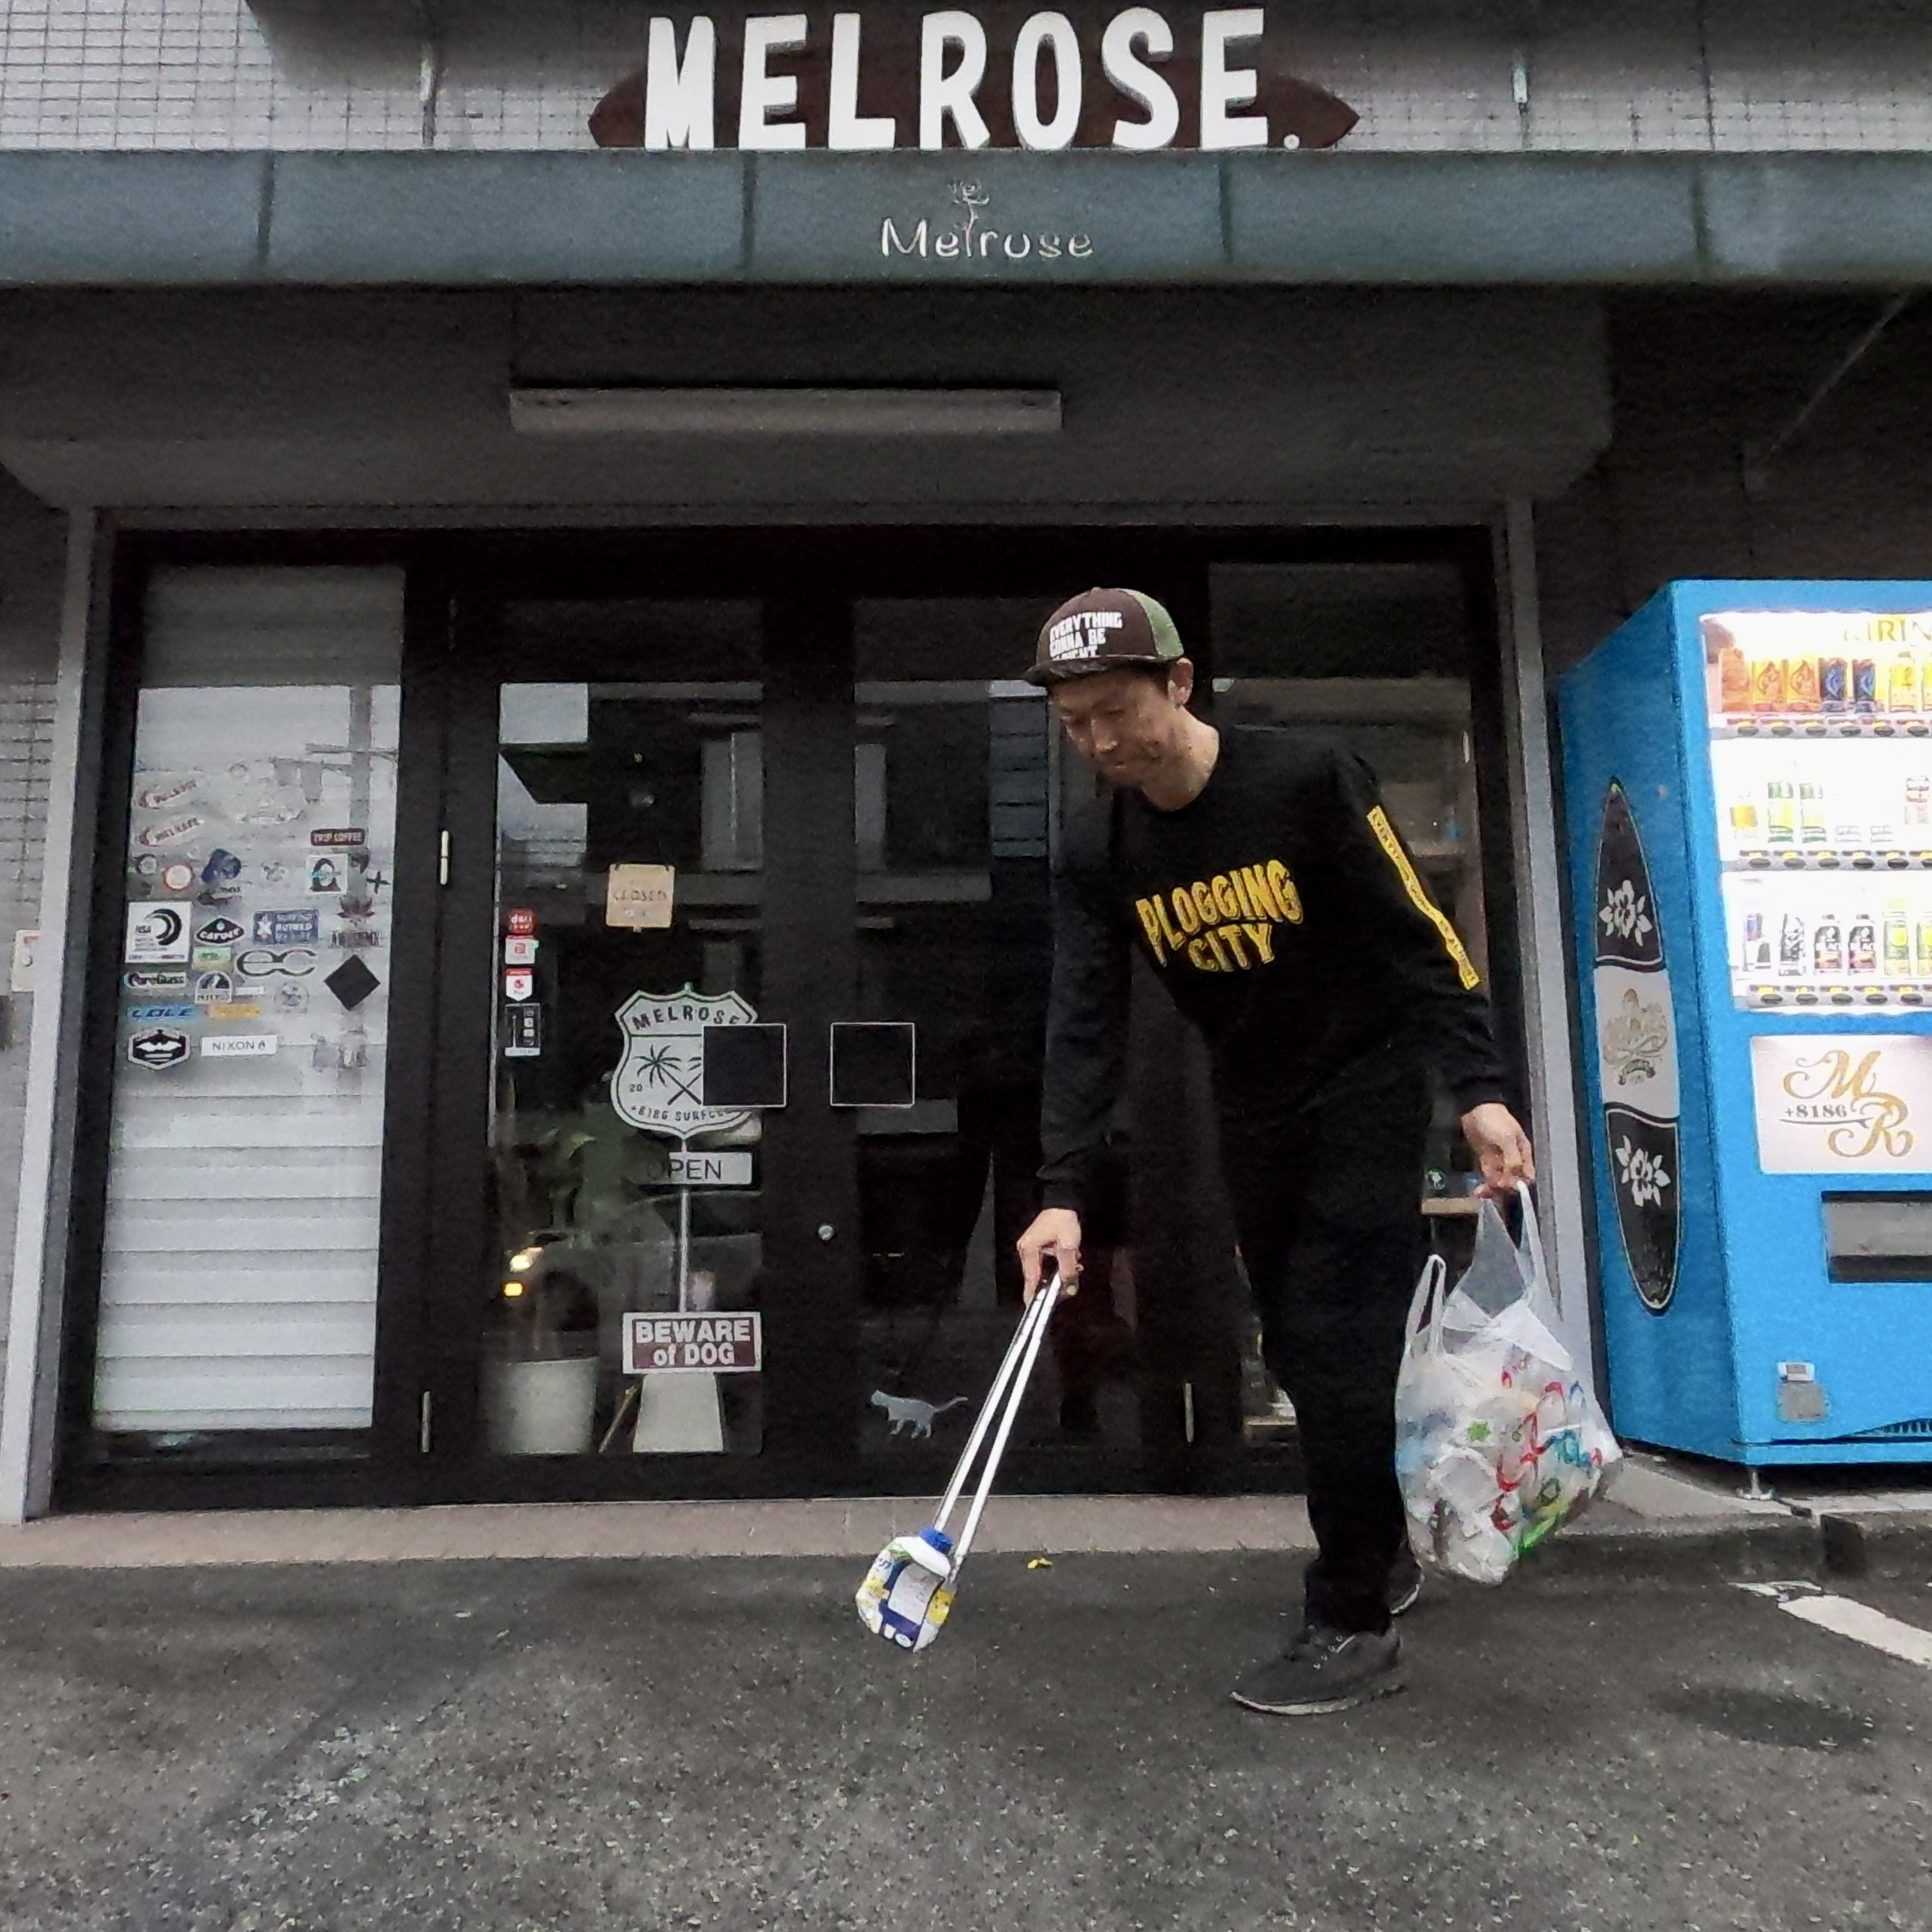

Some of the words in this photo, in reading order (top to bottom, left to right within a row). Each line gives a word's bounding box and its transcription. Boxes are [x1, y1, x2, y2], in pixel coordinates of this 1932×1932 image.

[645, 7, 1300, 151] MELROSE.
[1050, 612, 1123, 643] EVERYTHING
[1050, 632, 1084, 657] GONNA
[1088, 628, 1106, 646] BE
[1136, 860, 1304, 967] PLOGGING
[1188, 923, 1275, 971] CITY
[212, 1041, 254, 1051] NIXON
[1783, 1104, 1848, 1118] +8186
[636, 1320, 751, 1344] BEWARE
[653, 1344, 677, 1367] of
[684, 1342, 735, 1365] DOG
